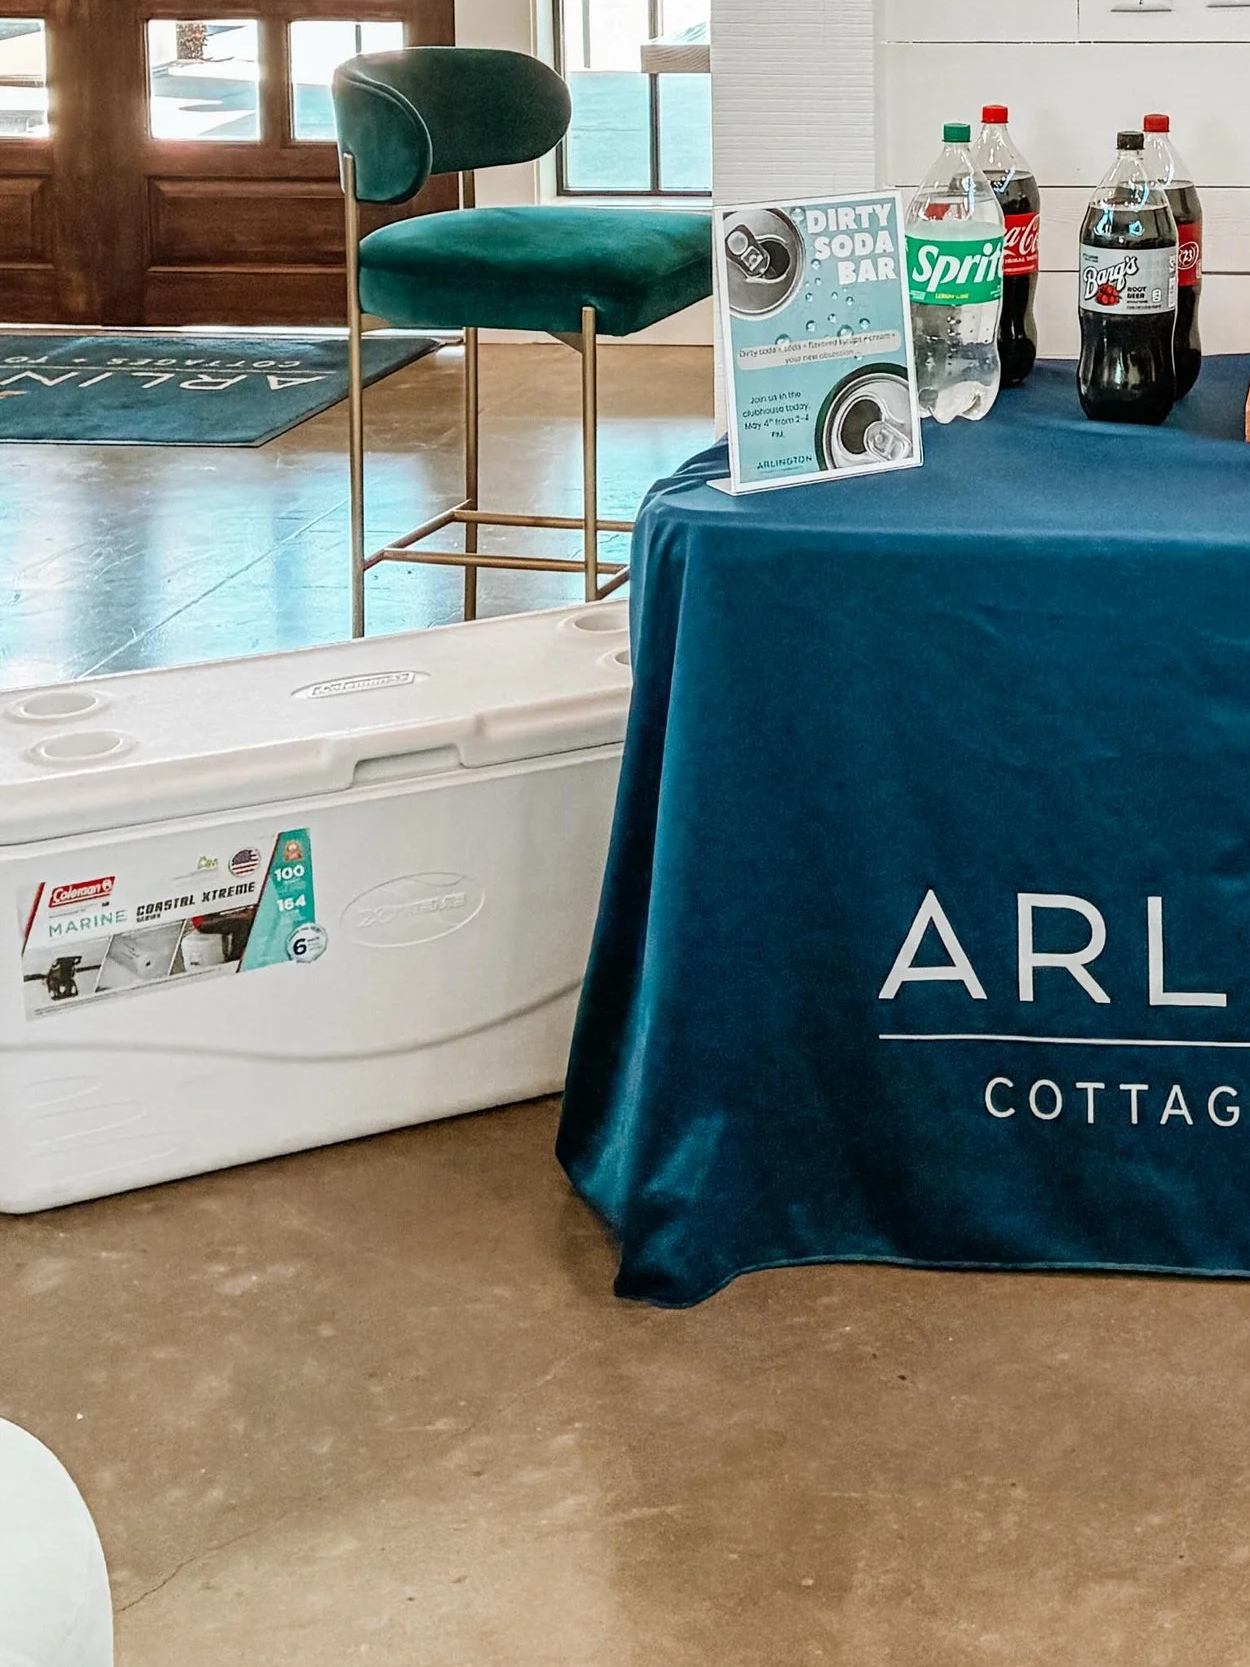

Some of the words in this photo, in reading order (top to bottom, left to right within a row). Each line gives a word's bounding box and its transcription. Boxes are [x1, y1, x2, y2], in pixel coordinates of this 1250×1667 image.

[806, 203, 892, 234] DIRTY
[814, 230, 894, 260] SODA
[838, 257, 897, 285] BAR
[1084, 256, 1139, 300] Barq's
[745, 422, 761, 430] May
[775, 417, 794, 426] from
[757, 455, 812, 470] ARLINGTON
[274, 865, 304, 881] 100
[53, 882, 102, 903] Coleman
[136, 895, 196, 917] COASTAL
[202, 882, 256, 903] XTREME
[276, 895, 306, 911] 164
[49, 910, 127, 937] MARINE
[293, 938, 307, 955] 6
